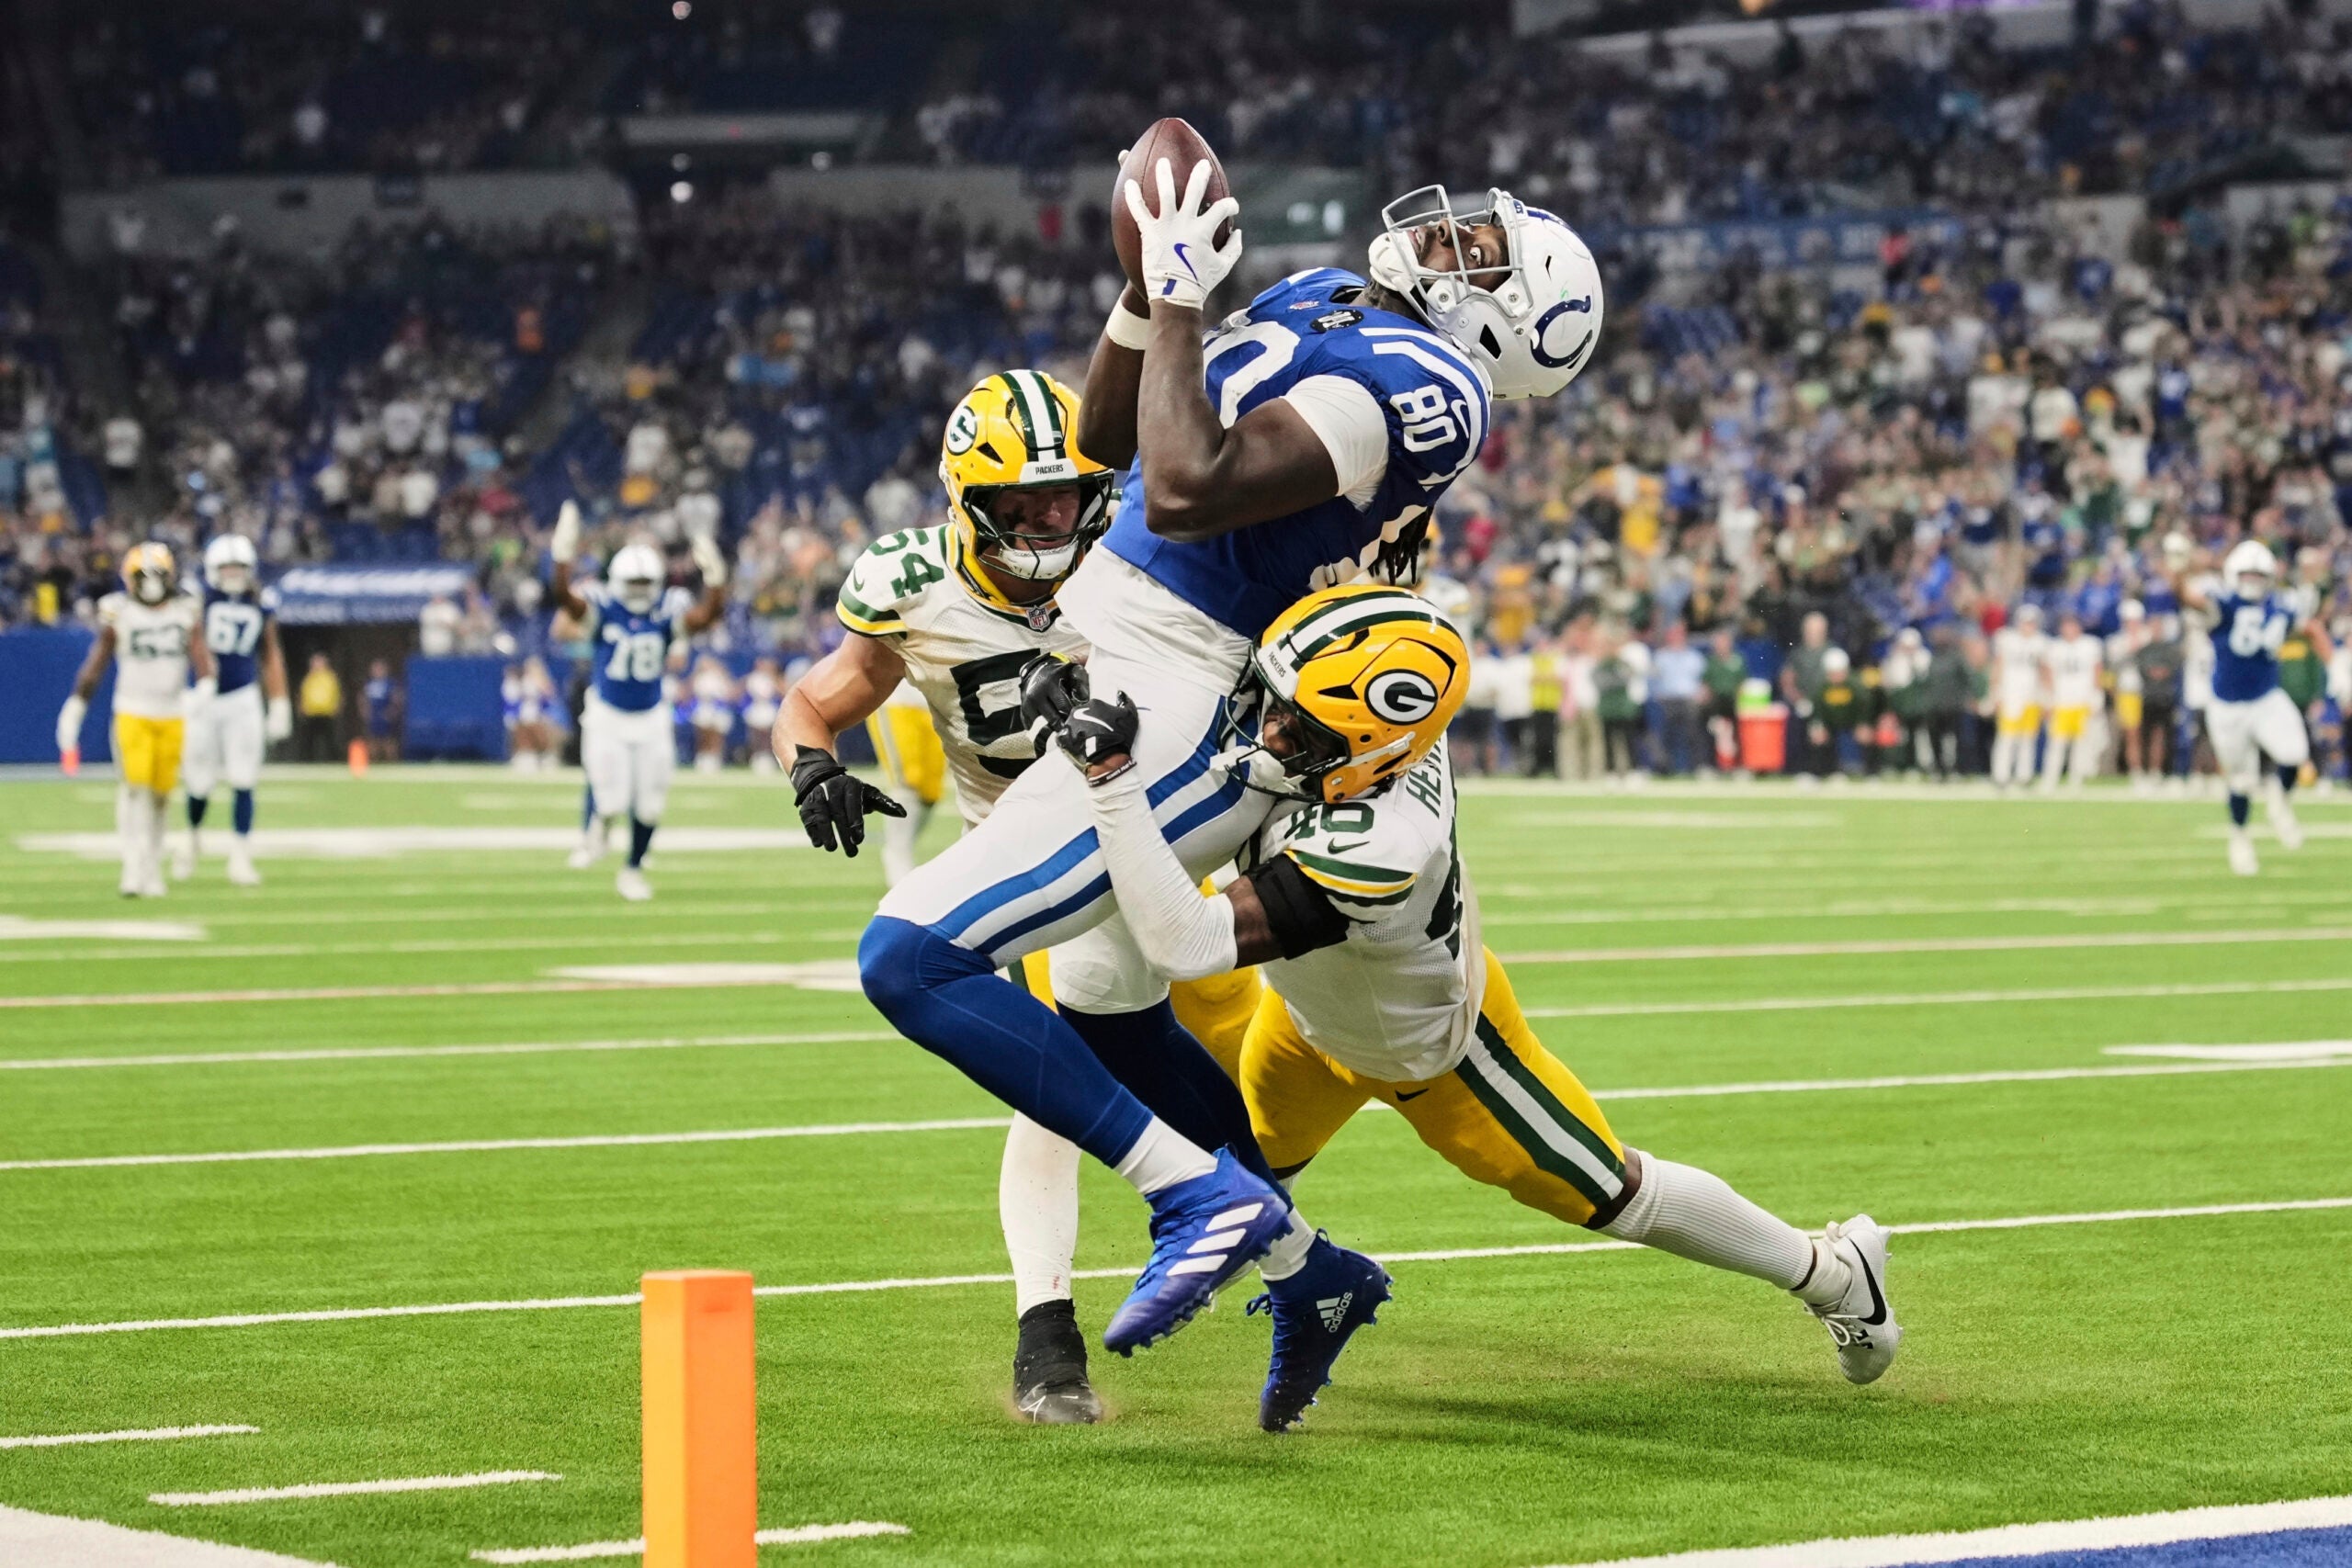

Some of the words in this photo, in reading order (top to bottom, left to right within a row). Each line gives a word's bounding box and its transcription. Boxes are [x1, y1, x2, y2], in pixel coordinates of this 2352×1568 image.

[1389, 385, 1457, 453] 80
[1035, 464, 1065, 476] PACKERS
[208, 601, 264, 657] 67
[1031, 615, 1048, 627] NFL
[602, 622, 665, 682] 78
[1267, 651, 1287, 678] PACKERS
[1283, 801, 1375, 840] 40
[1329, 1292, 1353, 1333] adidas
